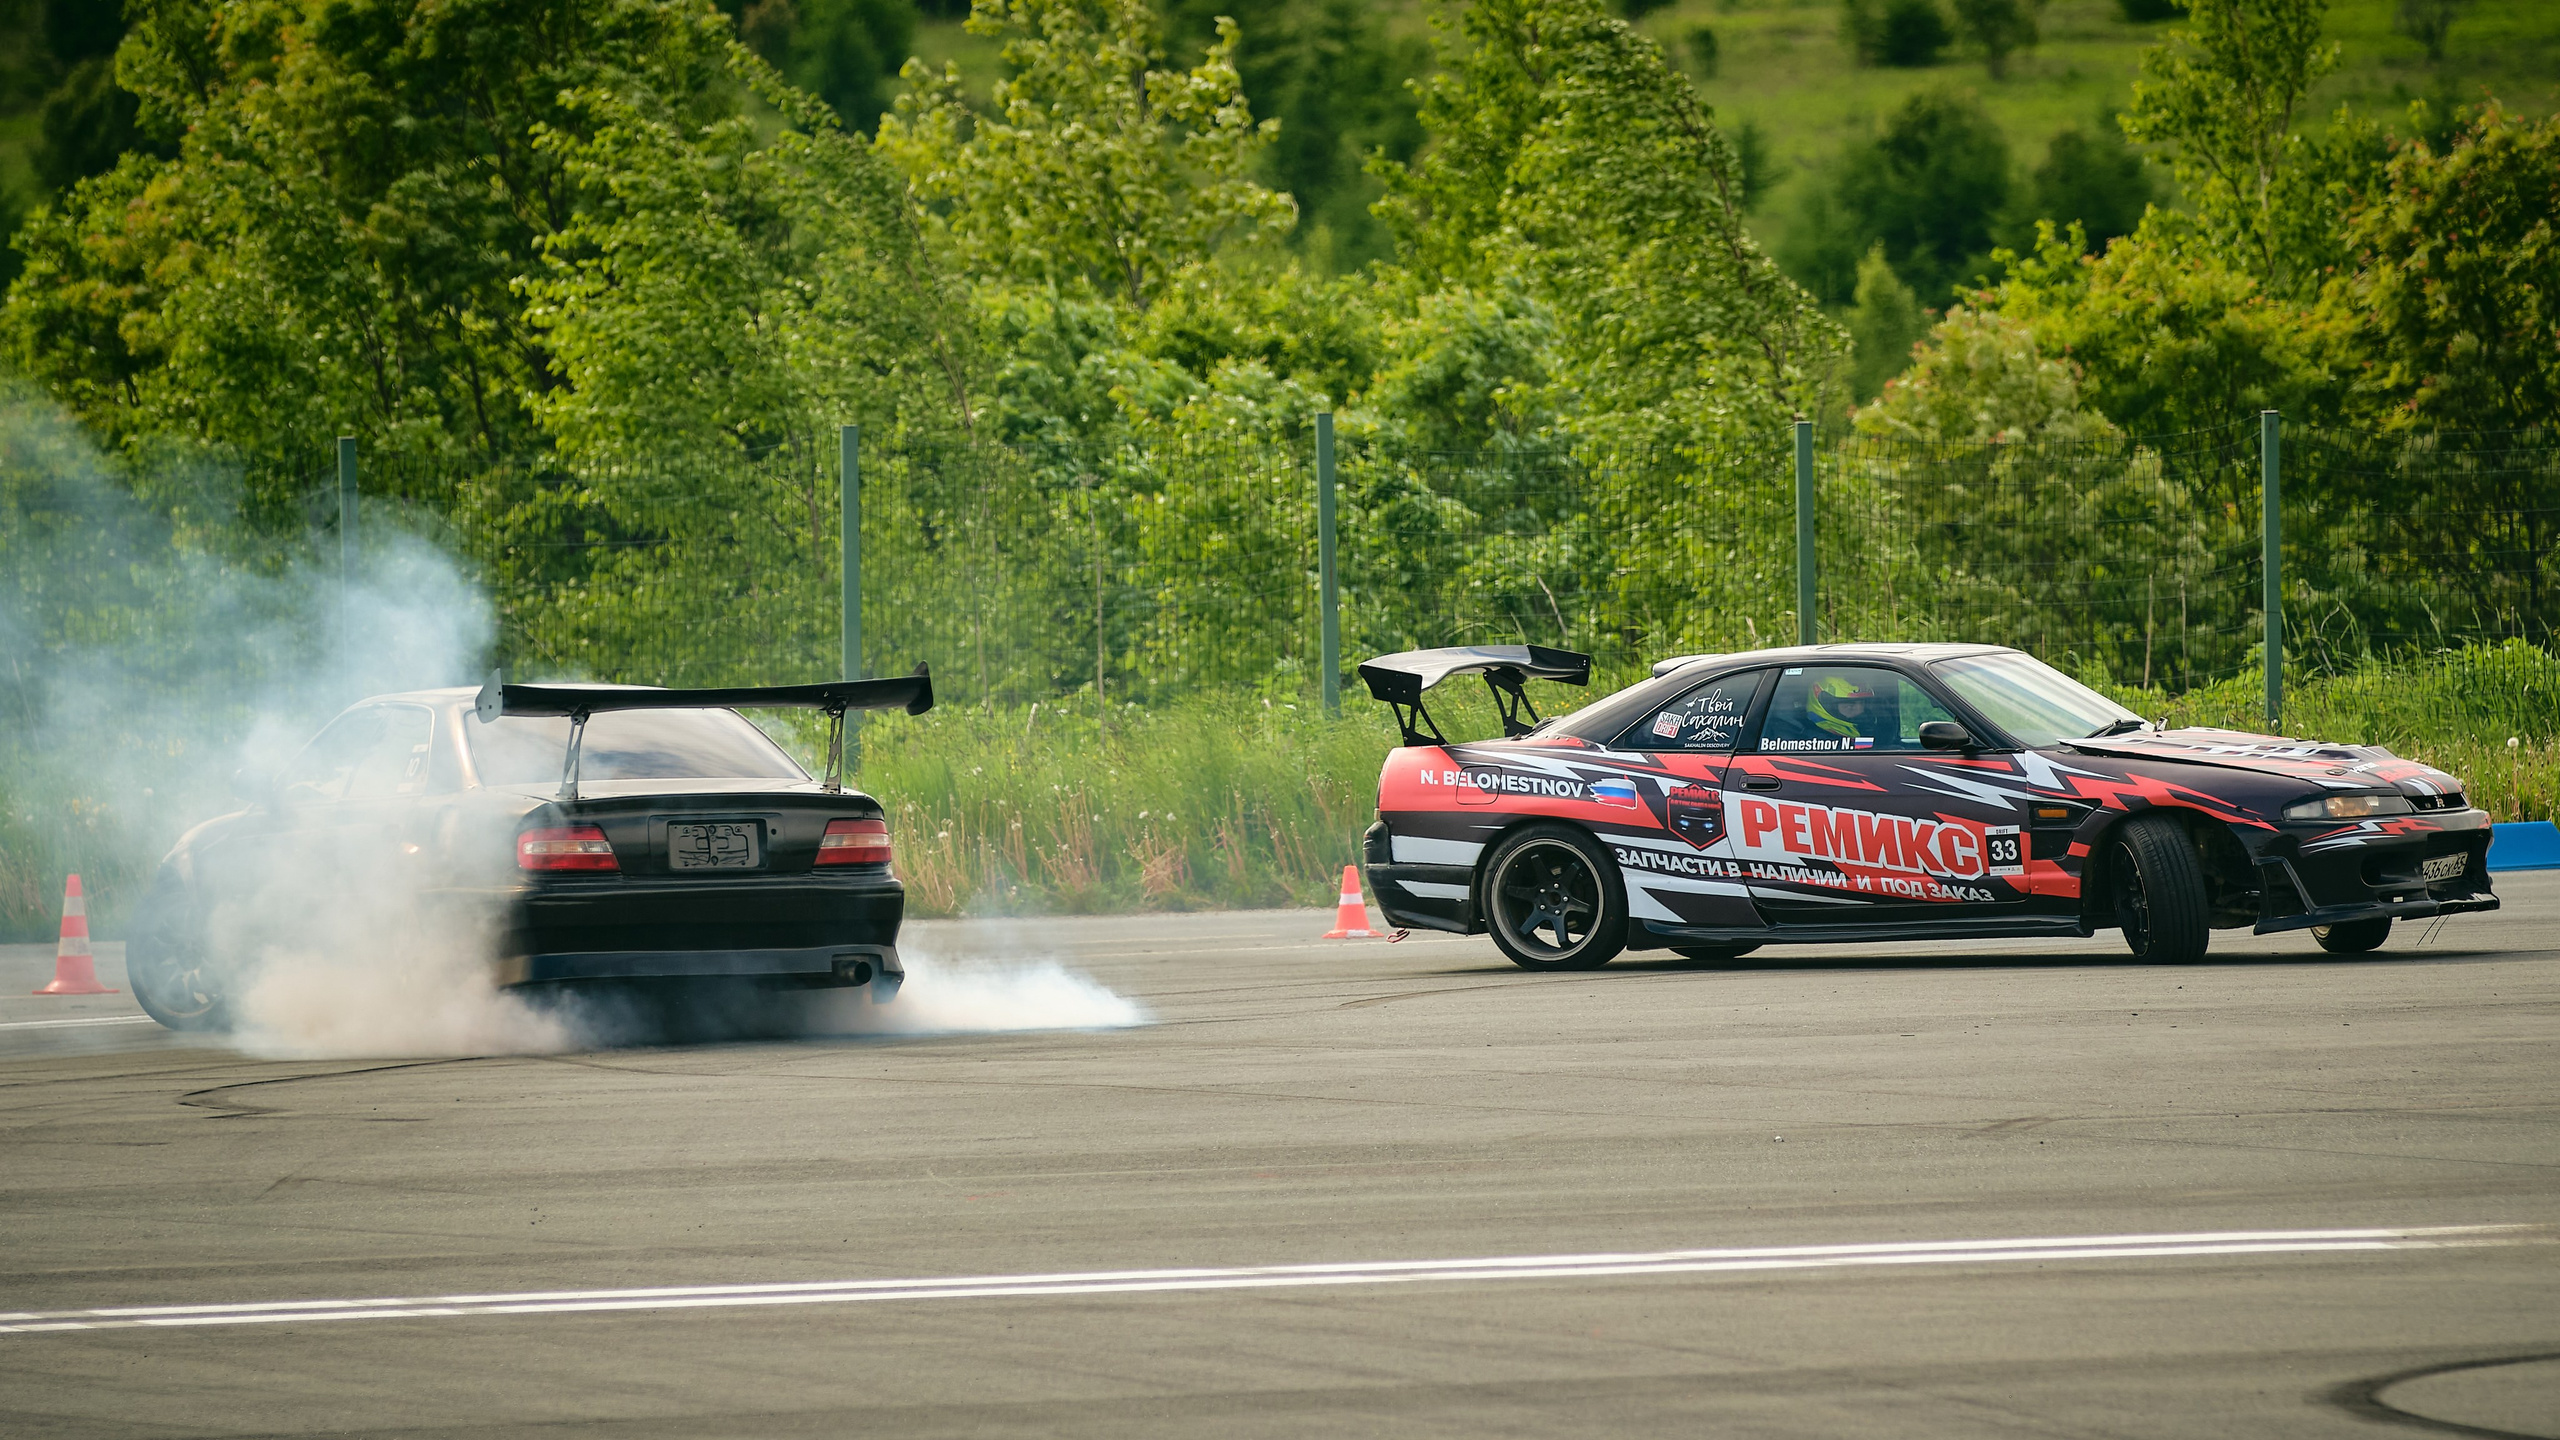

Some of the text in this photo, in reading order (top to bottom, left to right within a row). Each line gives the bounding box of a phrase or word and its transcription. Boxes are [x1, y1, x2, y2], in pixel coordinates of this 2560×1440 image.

[1697, 688, 1734, 713] Твой
[1655, 722, 1678, 736] DRIFT
[1659, 712, 1682, 726] SAKH
[1681, 711, 1745, 730] Сахалин
[1760, 737, 1854, 751] Belomestnov N.
[1420, 769, 1584, 798] N. BELOMESTNOV
[1669, 786, 1720, 802] РЕМИКС
[1740, 799, 1982, 878] РЕМИКС
[1991, 839, 2018, 861] 33
[1614, 847, 1996, 902] ЗАПЧАСТИ В НАЛИЧИИ И ПОД ЗАКАЗ
